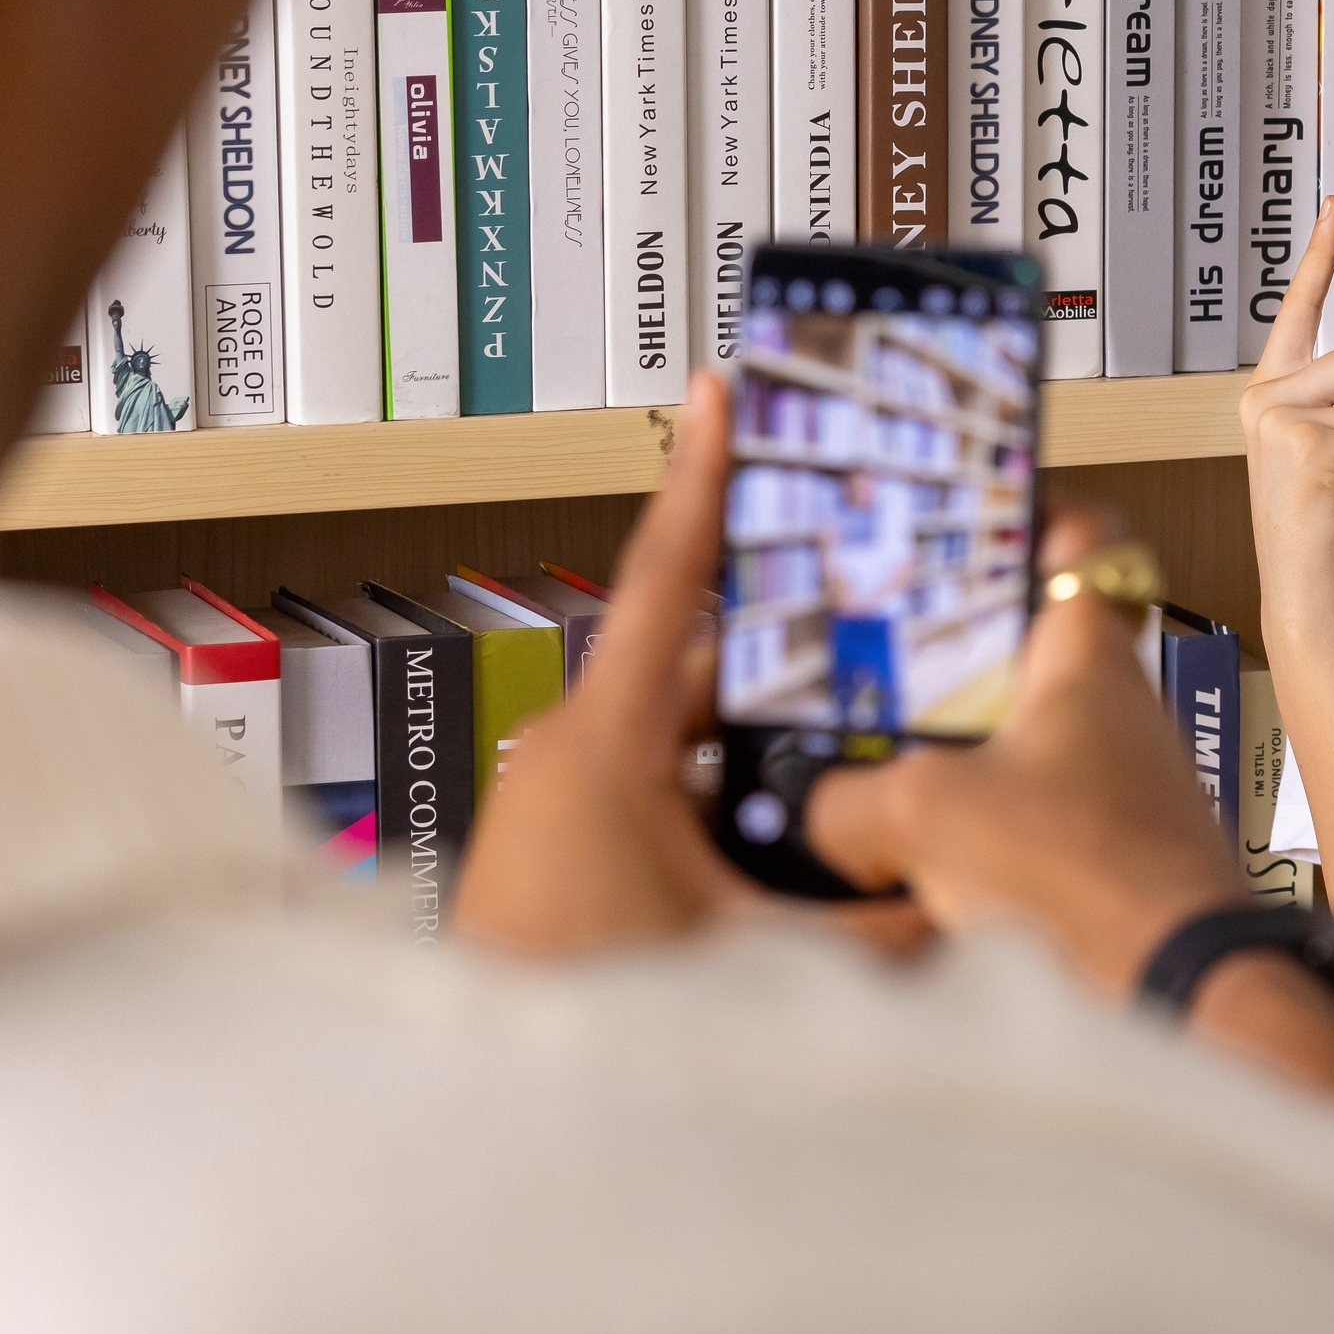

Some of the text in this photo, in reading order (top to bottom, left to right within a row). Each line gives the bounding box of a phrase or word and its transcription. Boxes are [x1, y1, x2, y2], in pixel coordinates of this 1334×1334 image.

[638, 5, 655, 77] Times
[807, 4, 816, 37] clothes,
[809, 38, 818, 58] your
[807, 63, 818, 91] Change
[343, 48, 360, 193] Ineightydays
[411, 84, 432, 159] olivia
[563, 90, 579, 131] YOU,
[639, 84, 656, 138] Yark
[220, 106, 255, 254] SHELDON
[641, 148, 657, 194] New
[970, 83, 999, 224] SHELDON
[1190, 127, 1223, 322] His dream
[1250, 118, 1303, 323] Ordinary
[637, 232, 666, 369] SHELDON
[216, 299, 238, 397] ANGELS
[401, 370, 450, 383] Furniture
[244, 372, 264, 403] OF
[407, 647, 435, 770] METRO
[1254, 741, 1266, 799] I'M STILL
[1271, 727, 1282, 756] YOU
